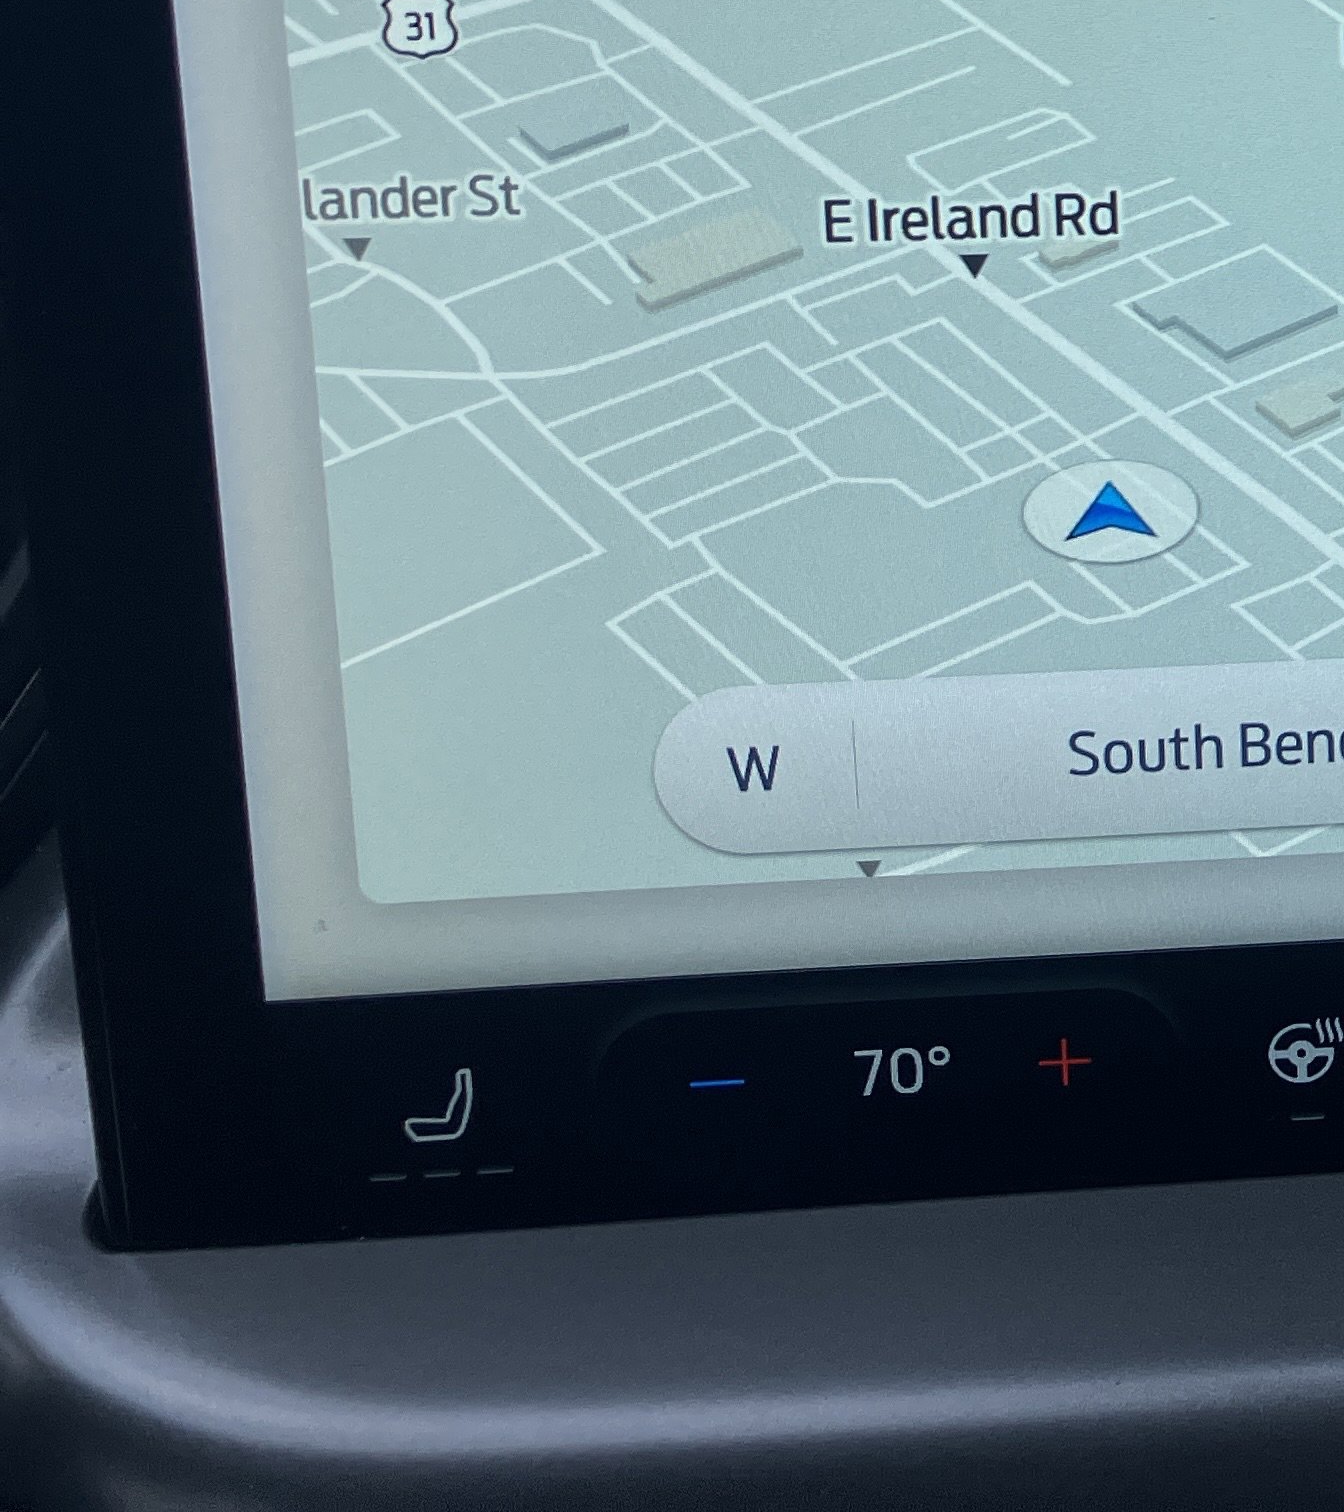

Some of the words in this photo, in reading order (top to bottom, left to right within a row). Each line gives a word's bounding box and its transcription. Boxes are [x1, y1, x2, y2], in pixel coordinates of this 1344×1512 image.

[404, 11, 436, 41] 31
[469, 174, 521, 218] St
[824, 198, 854, 244] E
[867, 193, 1040, 243] Ireland
[1055, 190, 1120, 237] Rd
[727, 745, 780, 793] W
[1068, 723, 1224, 778] South
[853, 1045, 951, 1097] 70°
